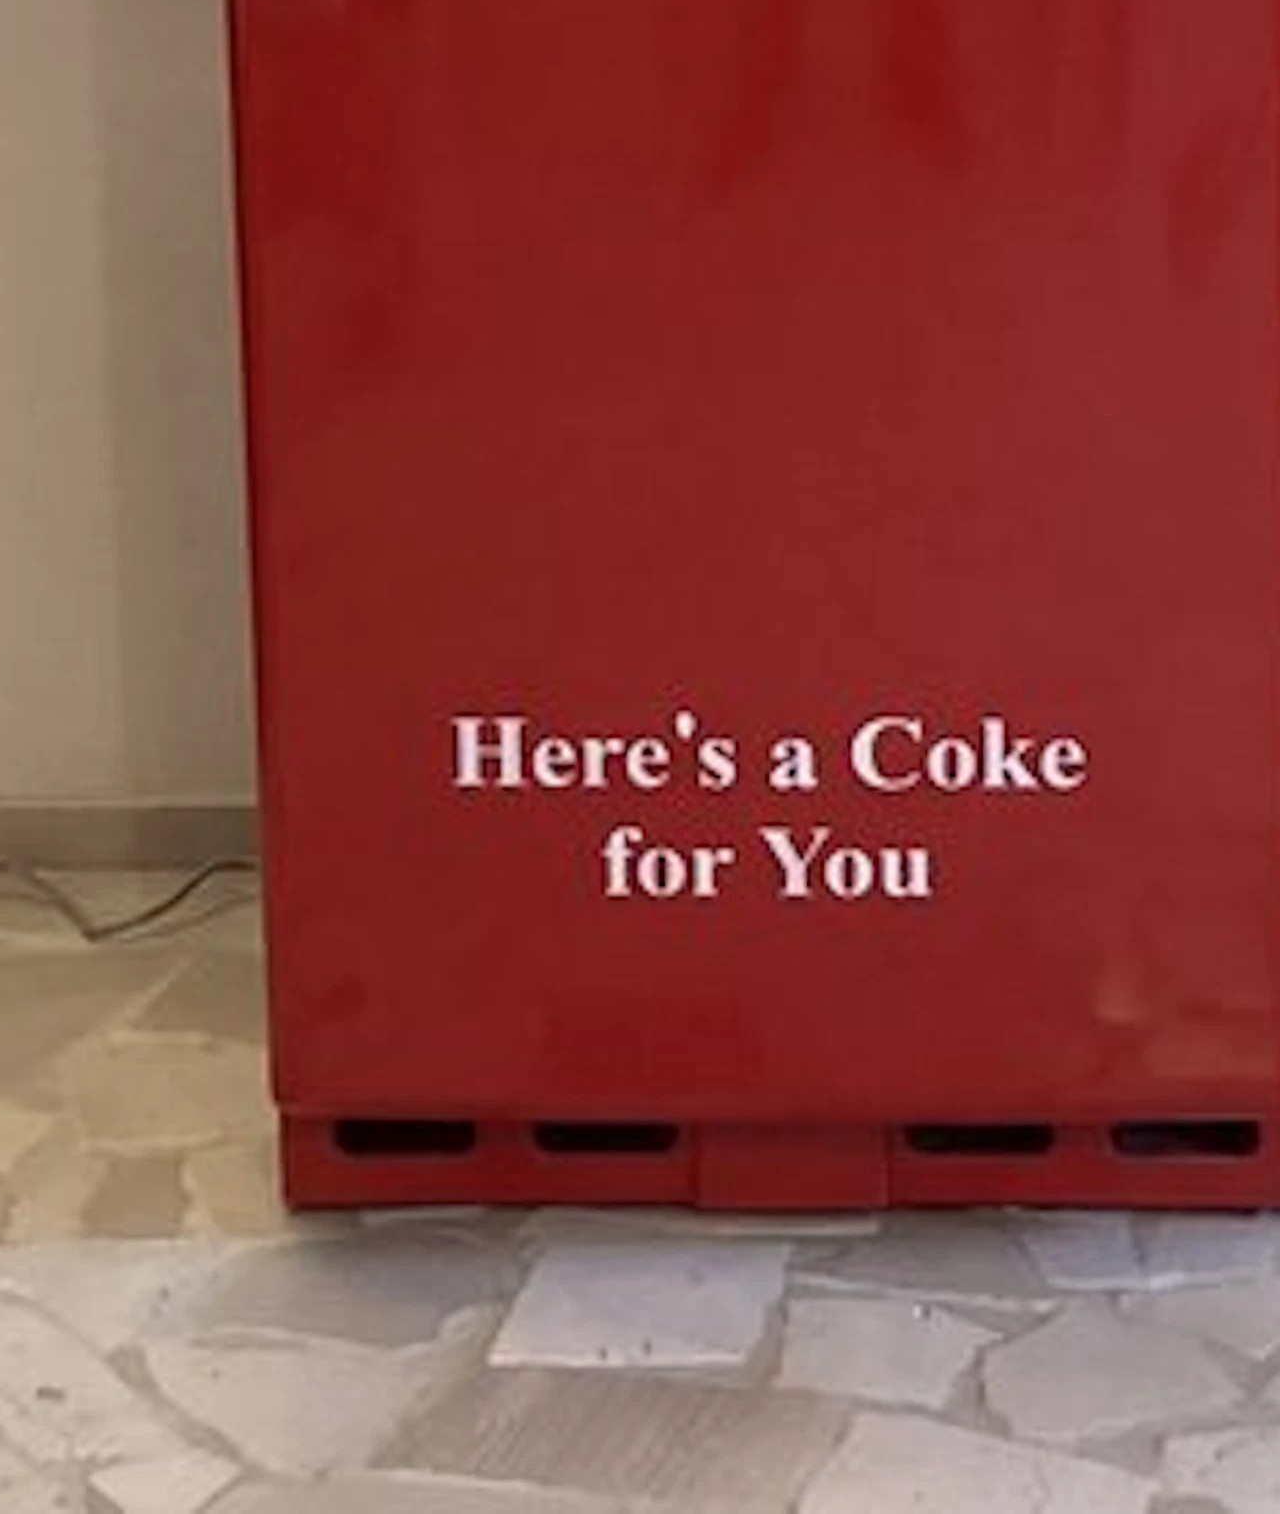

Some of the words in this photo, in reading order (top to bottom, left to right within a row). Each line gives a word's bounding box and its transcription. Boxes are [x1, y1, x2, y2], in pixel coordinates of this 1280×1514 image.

[452, 710, 737, 790] Here's
[769, 737, 819, 790] a
[850, 716, 1087, 792] Coke
[602, 826, 736, 897] for
[759, 826, 932, 898] You
